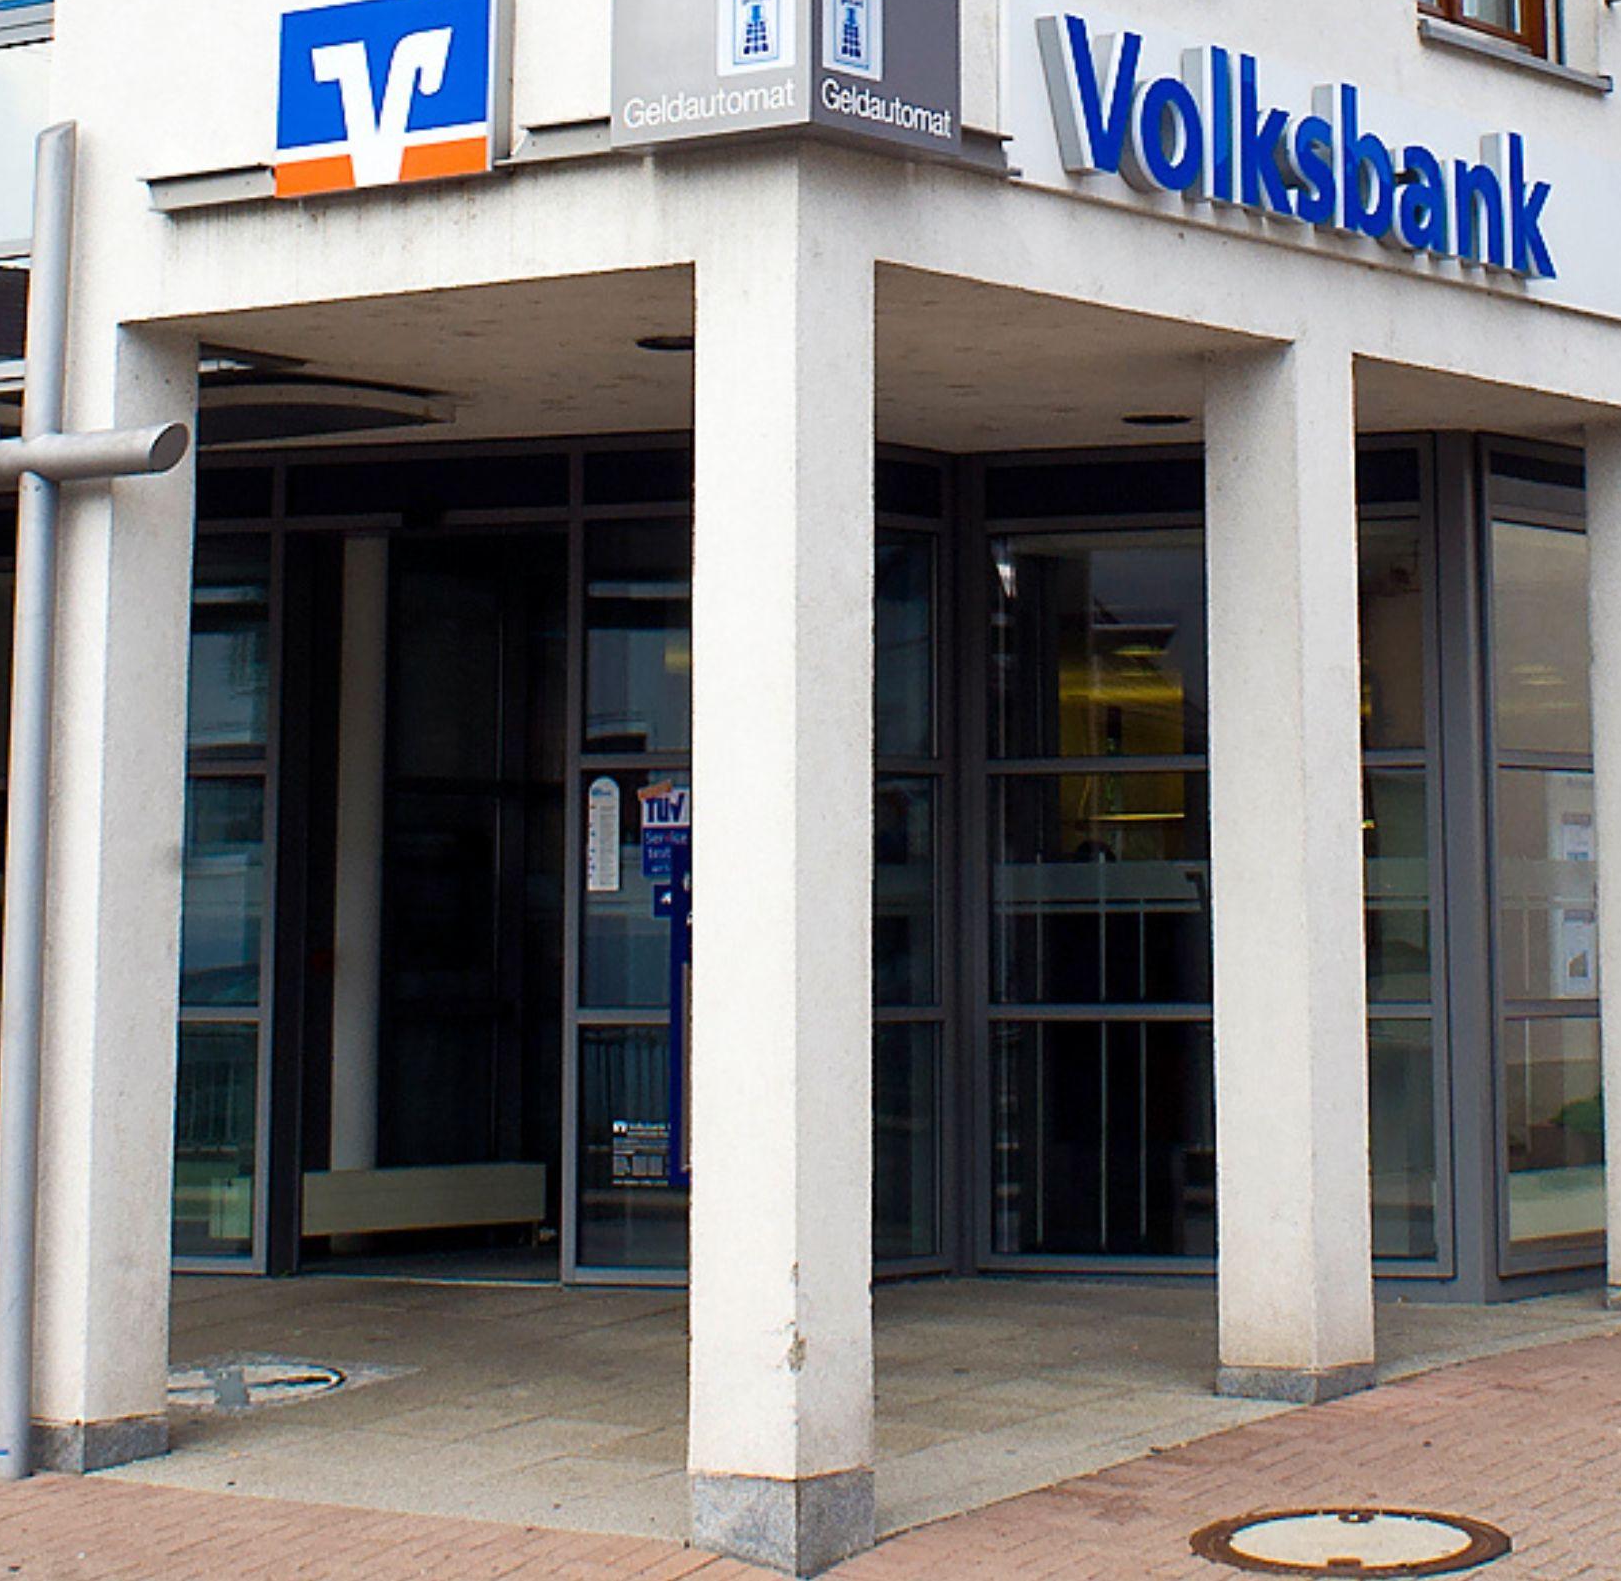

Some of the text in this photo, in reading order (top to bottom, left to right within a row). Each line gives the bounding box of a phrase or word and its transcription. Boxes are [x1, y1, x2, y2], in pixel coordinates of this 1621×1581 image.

[623, 78, 796, 128] Geldautomat
[821, 77, 953, 139] Geldautomat
[1059, 12, 1557, 280] Volksbank
